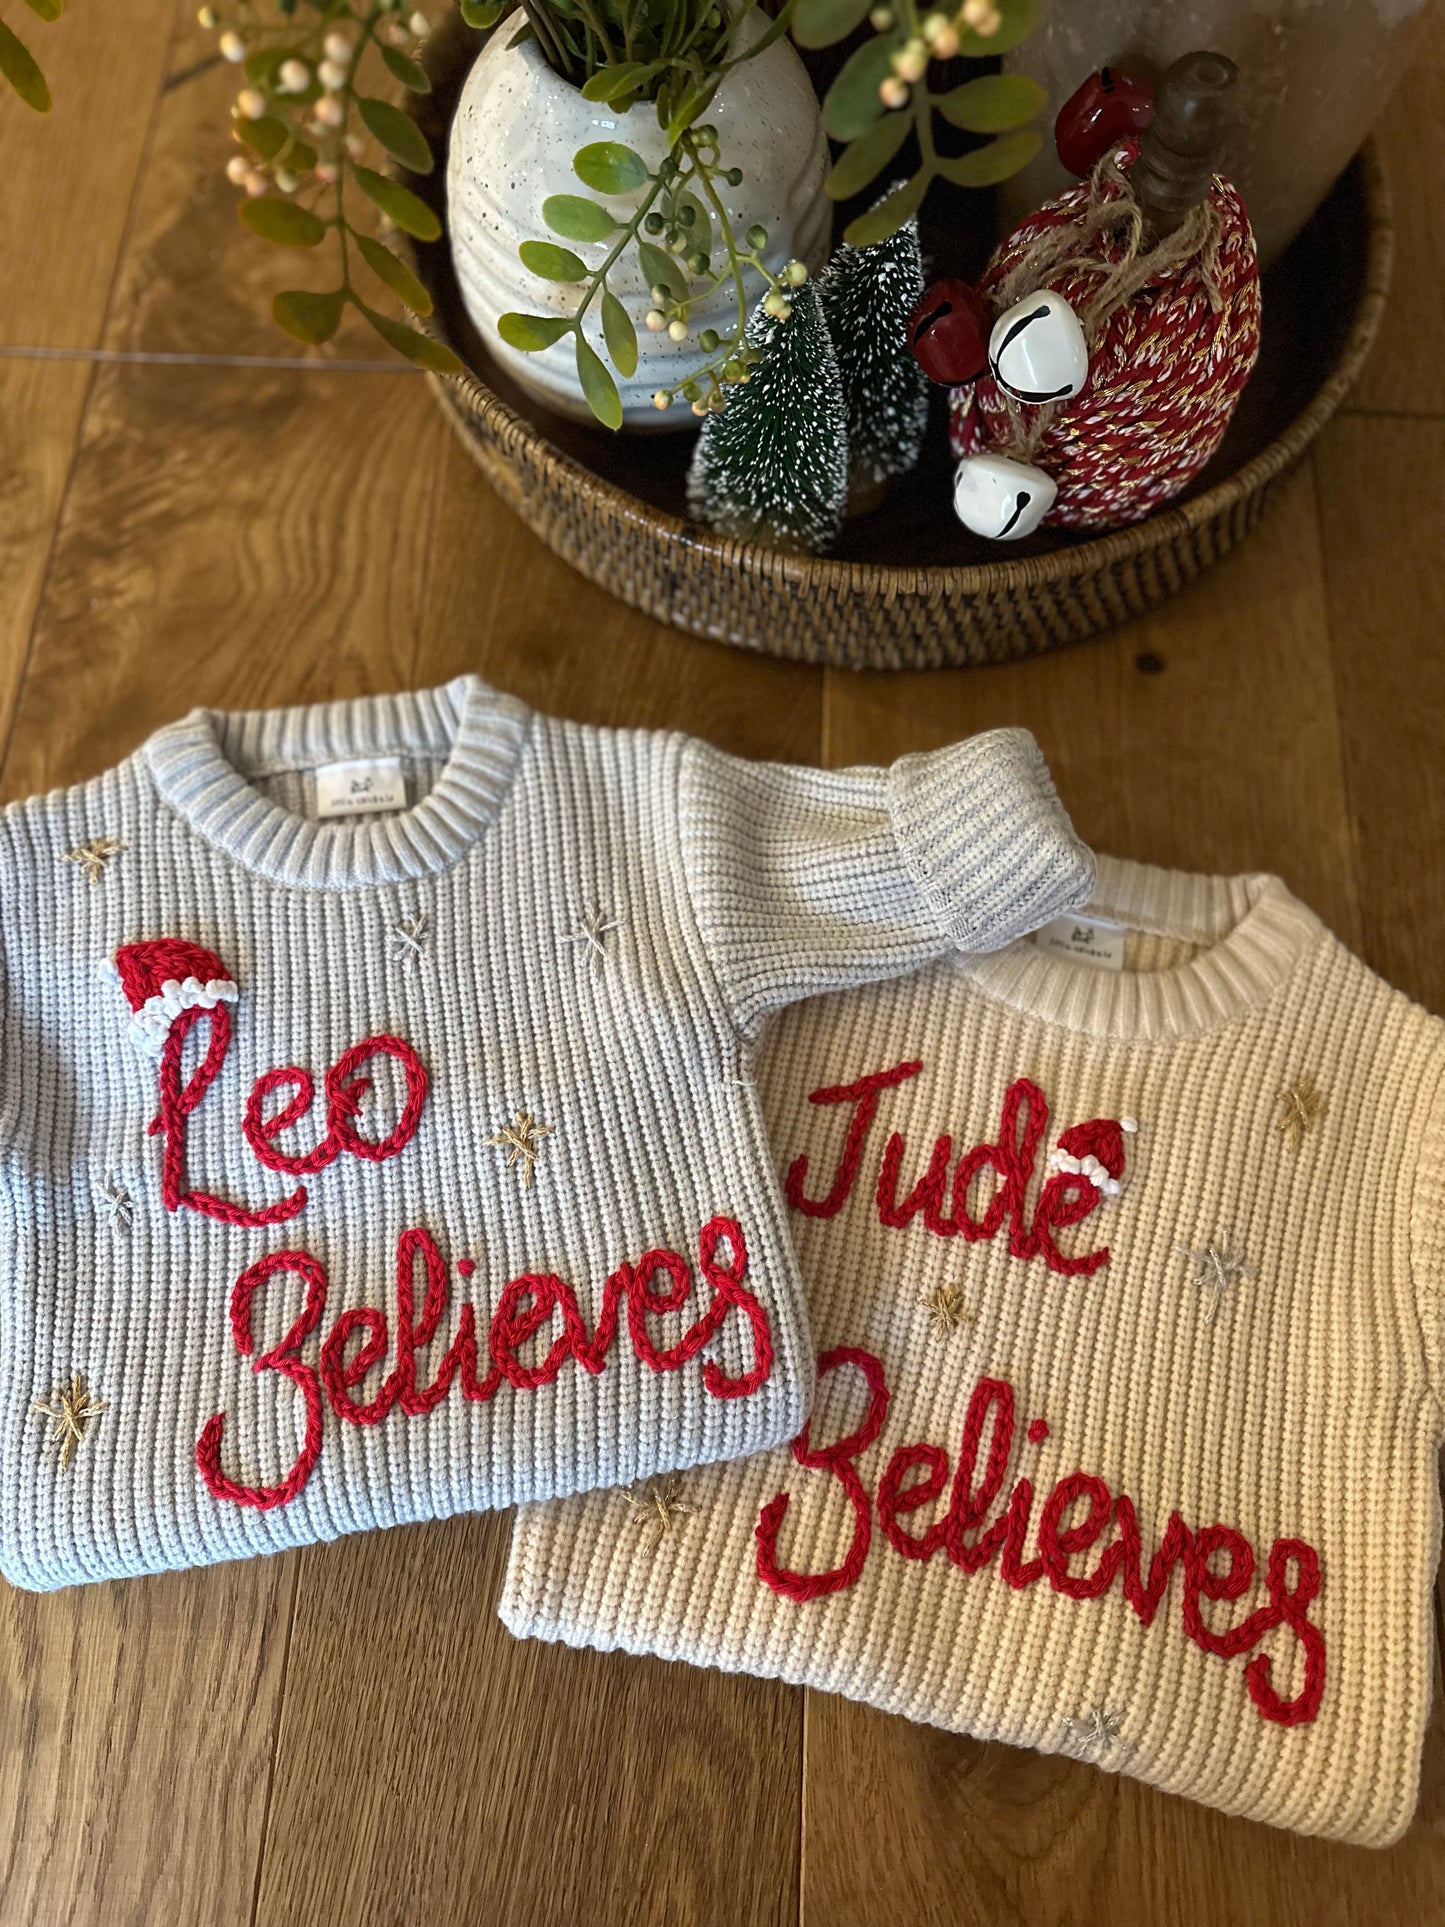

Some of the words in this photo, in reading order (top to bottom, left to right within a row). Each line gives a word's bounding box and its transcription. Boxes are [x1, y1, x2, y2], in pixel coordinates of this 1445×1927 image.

[149, 1002, 429, 1227] Leo
[786, 1060, 1110, 1277] Jude
[196, 1216, 775, 1511] Believes
[755, 1345, 1326, 1727] Believes
